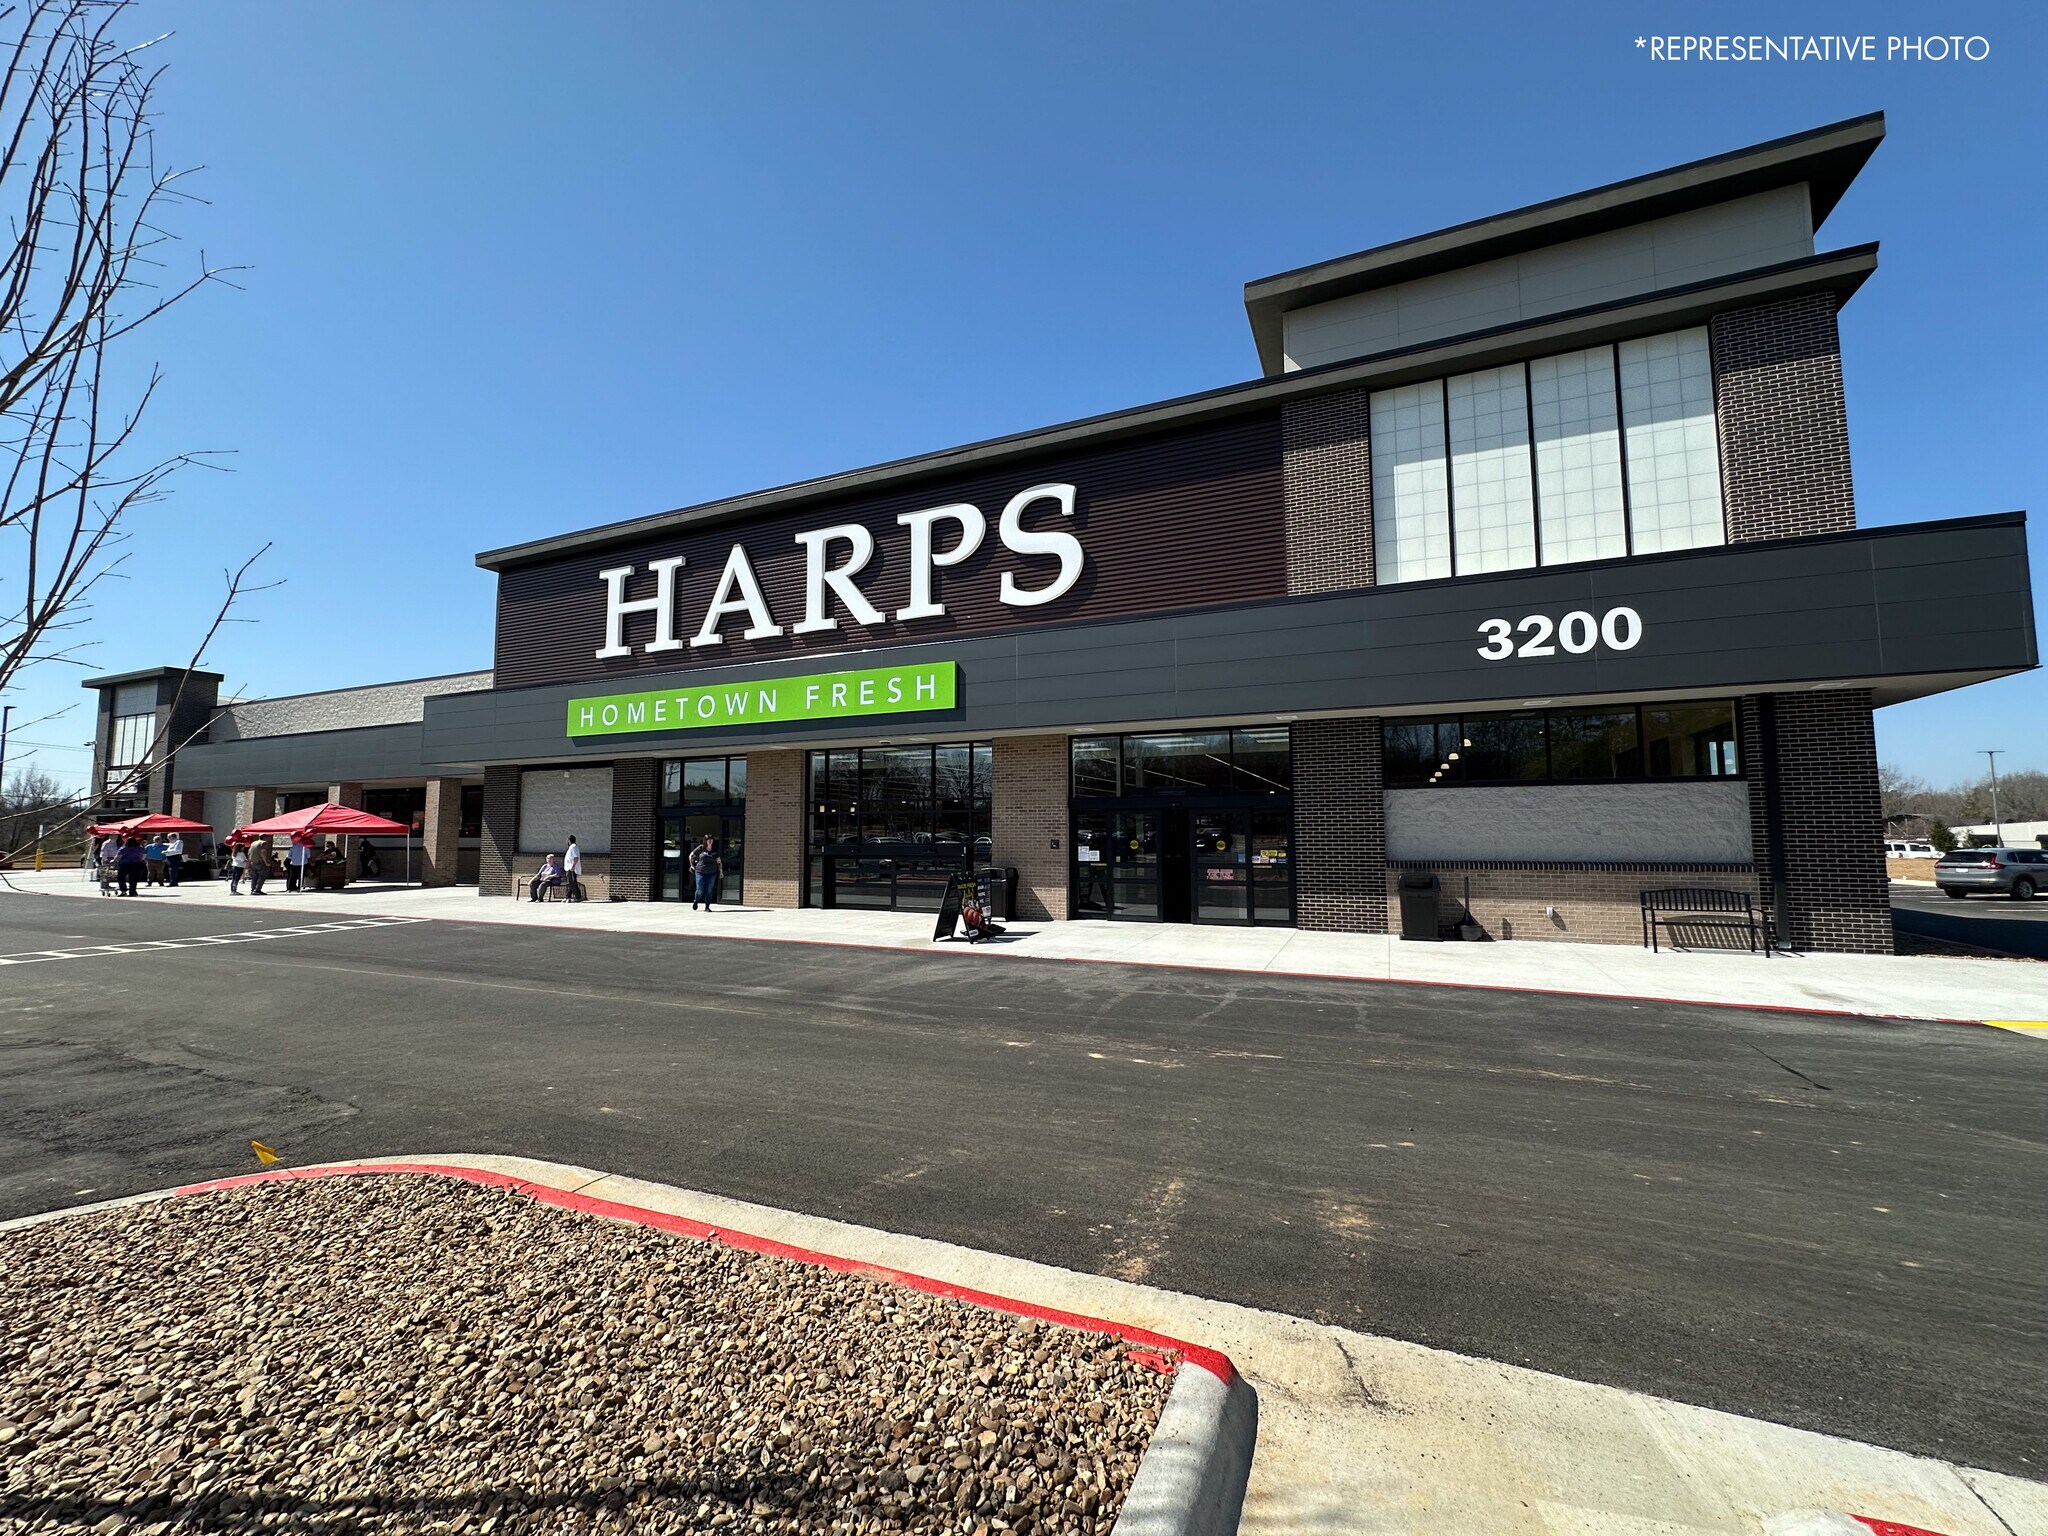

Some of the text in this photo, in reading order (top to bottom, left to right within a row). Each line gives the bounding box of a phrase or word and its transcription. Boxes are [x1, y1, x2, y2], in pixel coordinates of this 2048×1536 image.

[595, 482, 1085, 659] HARPS
[1476, 606, 1643, 661] 3200
[579, 674, 936, 728] HOMETOWN FRESH
